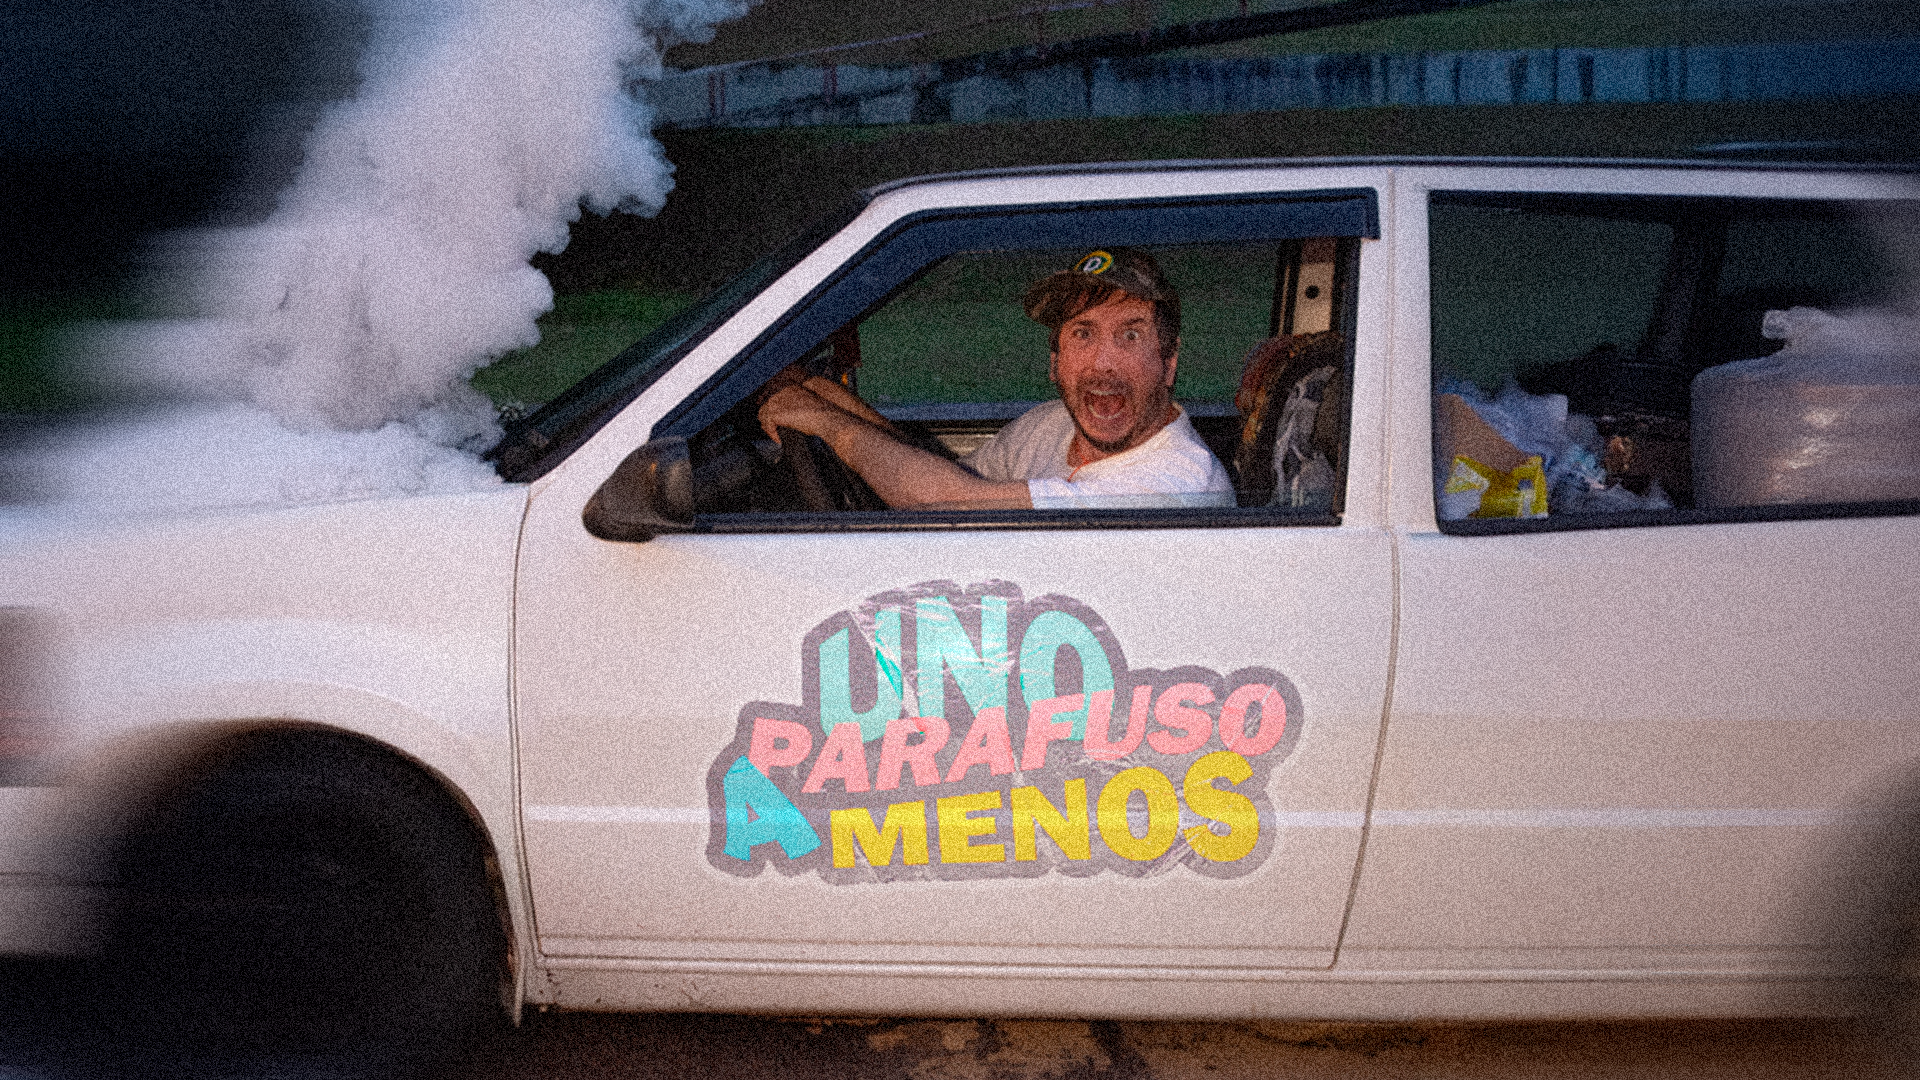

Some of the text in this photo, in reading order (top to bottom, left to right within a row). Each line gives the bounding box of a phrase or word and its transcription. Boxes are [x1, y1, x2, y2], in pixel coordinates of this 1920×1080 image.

[818, 595, 1115, 743] UNO
[748, 682, 1287, 793] PARAFUSO
[723, 751, 1261, 868] A MENOS
